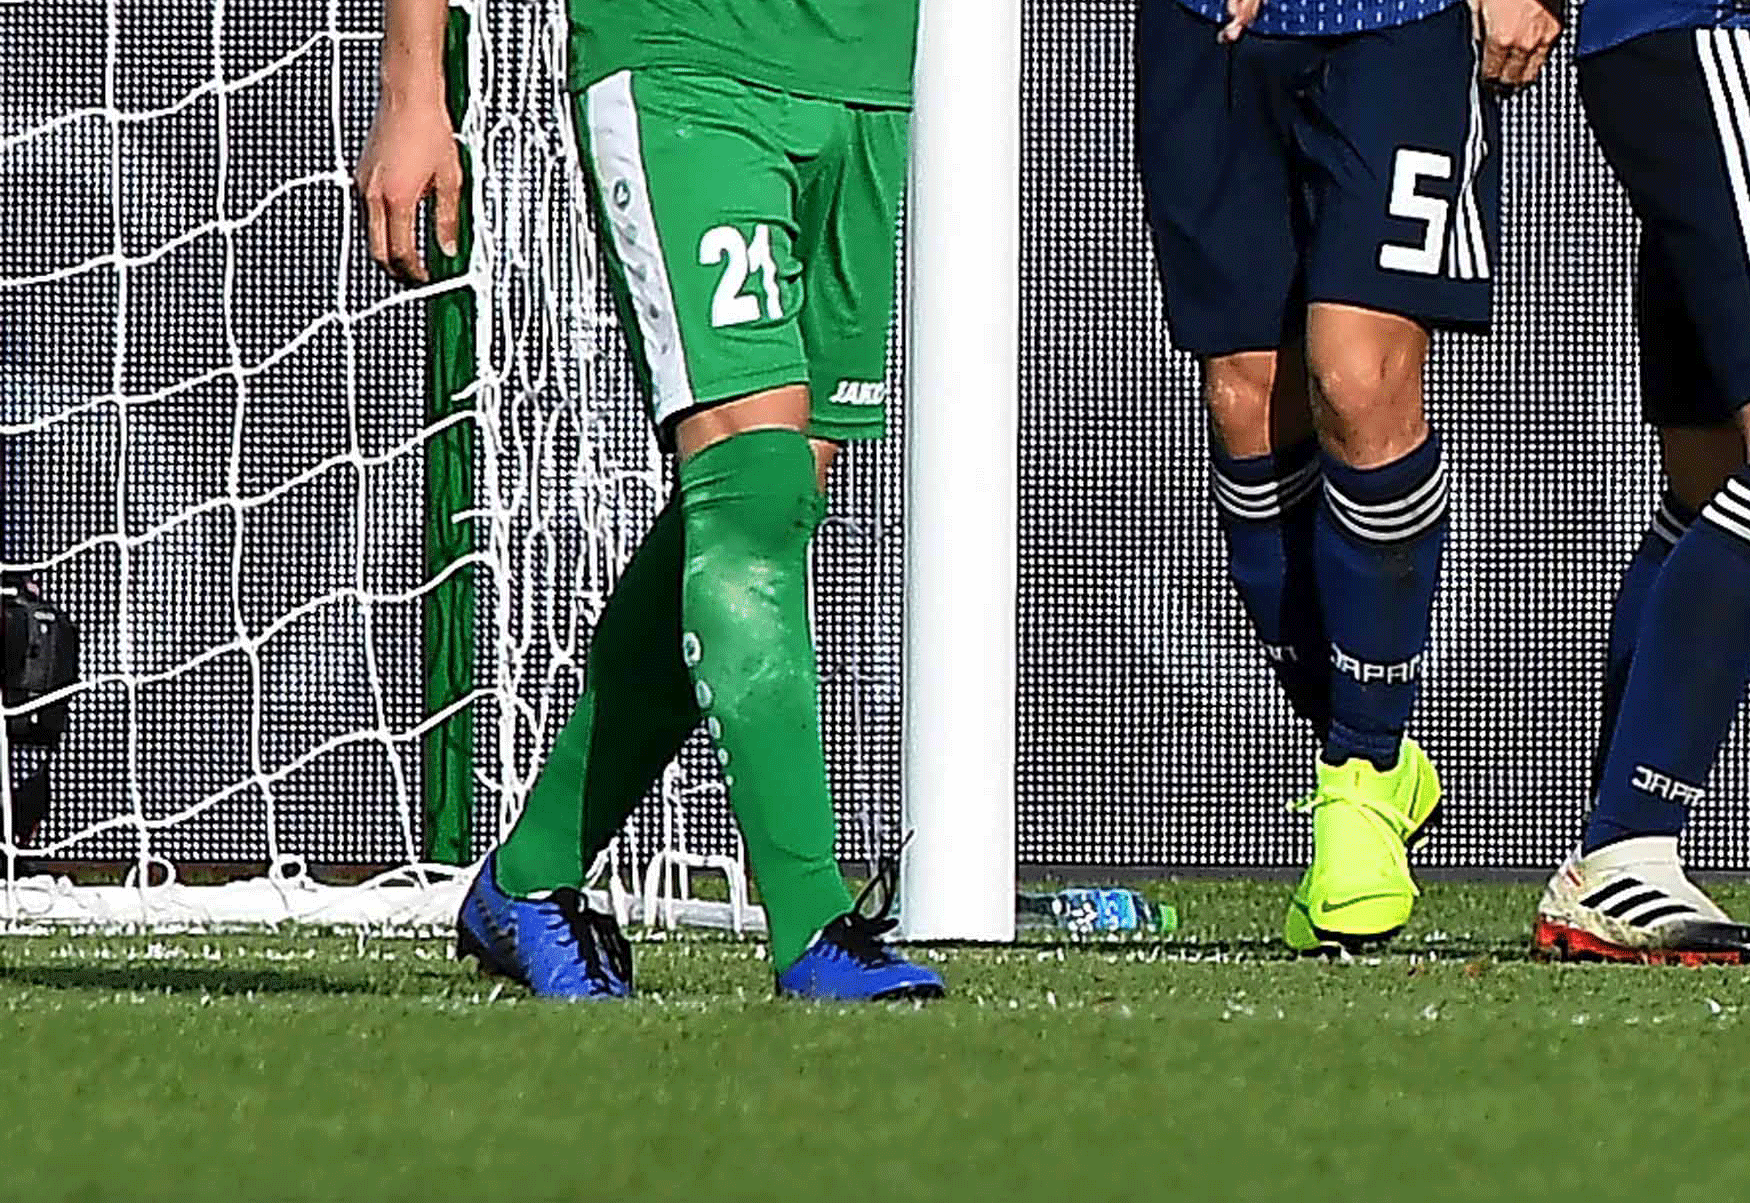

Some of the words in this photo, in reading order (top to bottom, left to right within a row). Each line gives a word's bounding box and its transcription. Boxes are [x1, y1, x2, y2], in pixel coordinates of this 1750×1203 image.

[1379, 149, 1451, 275] 5
[699, 224, 783, 327] 21
[1631, 764, 1706, 808] JAPA
